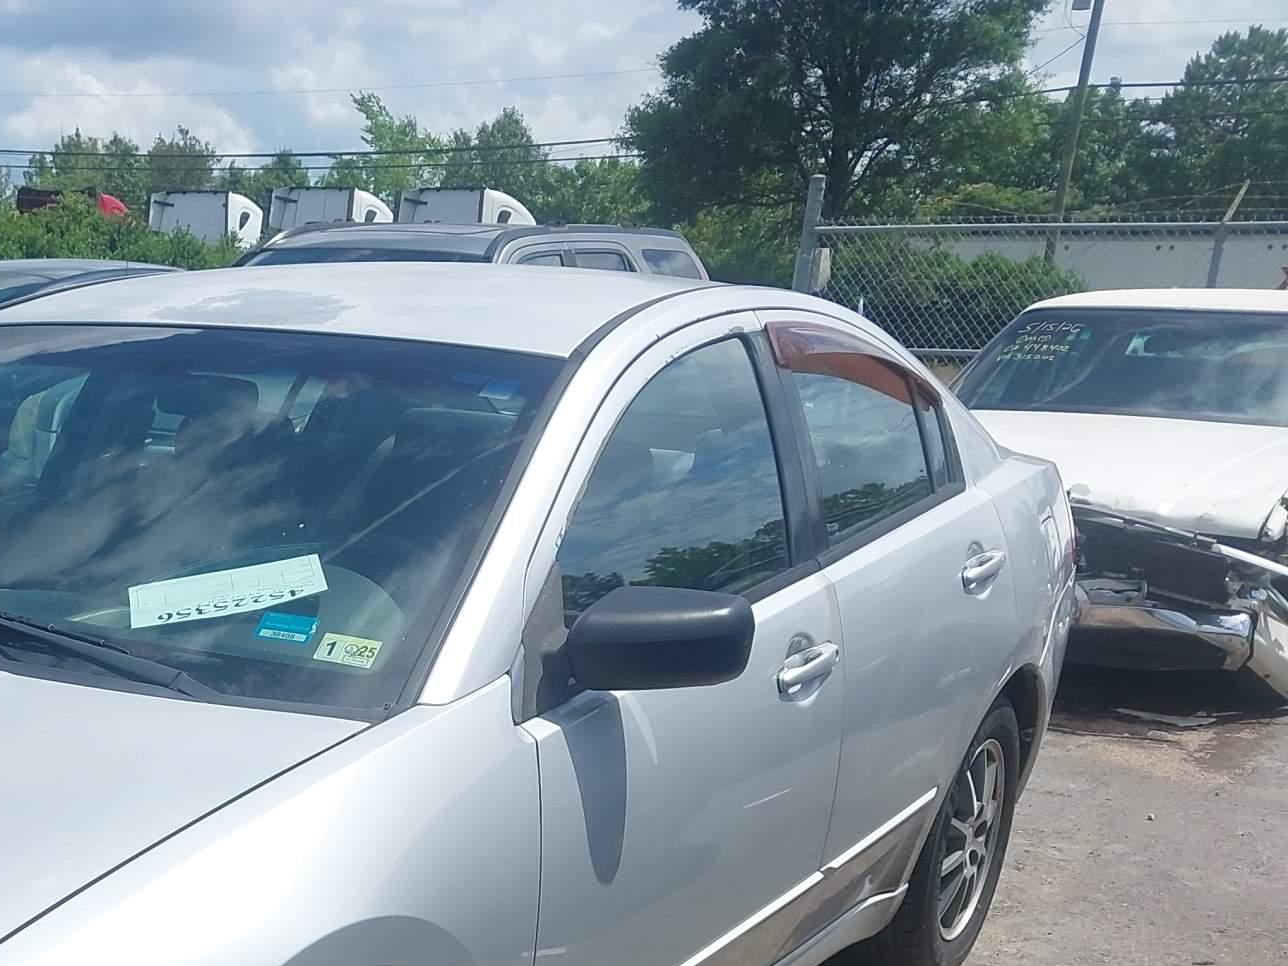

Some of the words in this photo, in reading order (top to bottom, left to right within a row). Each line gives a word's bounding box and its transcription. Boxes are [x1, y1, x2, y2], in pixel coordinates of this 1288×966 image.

[157, 588, 304, 623] 45225356
[326, 640, 337, 657] 1
[358, 645, 377, 659] 25
